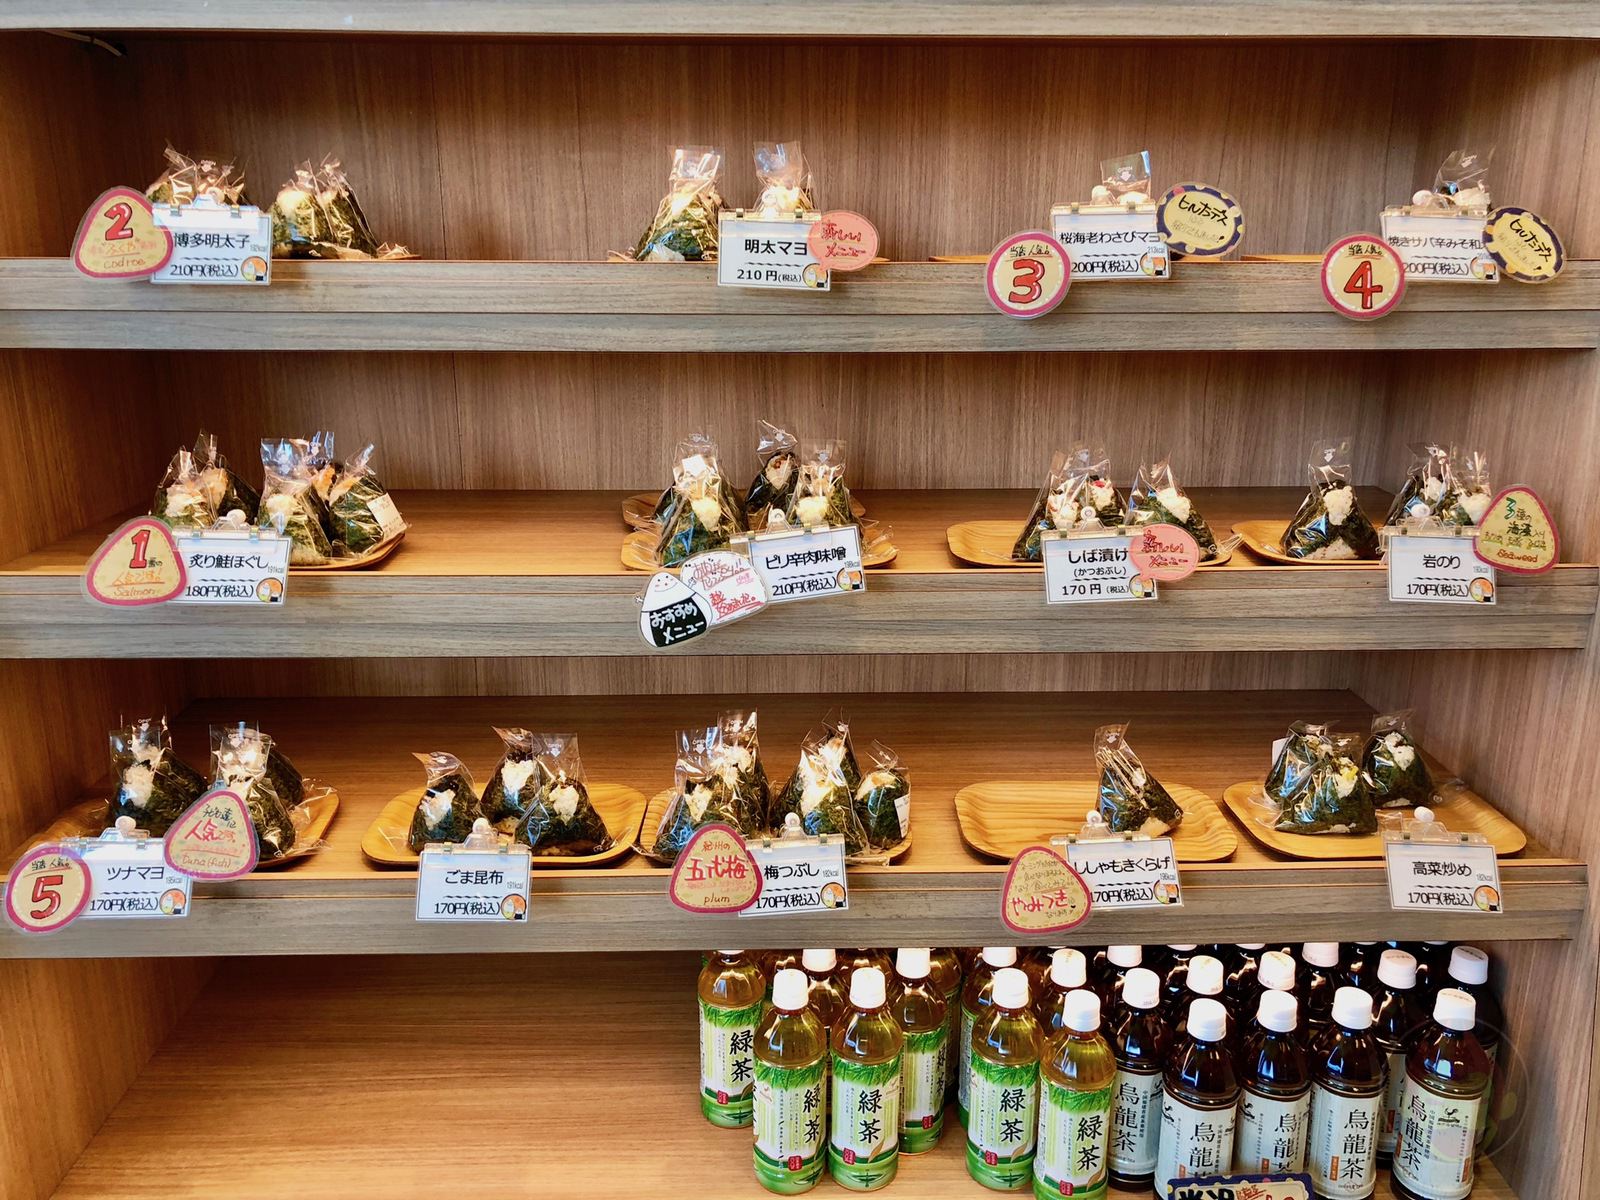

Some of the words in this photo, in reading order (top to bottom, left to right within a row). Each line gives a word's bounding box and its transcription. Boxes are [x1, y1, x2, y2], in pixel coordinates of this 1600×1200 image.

[104, 202, 133, 241] 2
[173, 233, 250, 249] 博多明太子
[744, 238, 808, 256] 明太マヨ
[1059, 231, 1162, 246] 桜海老わさびマヨ
[170, 263, 239, 277] 210円(税込)
[1071, 259, 1139, 274] 200円(税込)
[1403, 262, 1469, 276] 200円(税込)
[1008, 258, 1045, 304] 3
[1343, 260, 1383, 310] 4
[188, 553, 268, 569] 炙り鮭ほぐし
[765, 546, 847, 570] ピリ辛肉味噌
[1068, 547, 1128, 564] しば漬け
[1422, 554, 1461, 569] 岩のり
[1497, 548, 1538, 563] Seaweed
[1073, 566, 1127, 578] (かつおぶし)
[185, 584, 254, 598] 180円(税込)
[772, 576, 837, 597] 210円(税込)
[1407, 583, 1469, 597] 170円(税込)
[650, 602, 698, 630] おすすめ
[663, 620, 705, 644] メニュー
[107, 866, 165, 881] ツナマヨ
[684, 855, 749, 881] 五代梅
[764, 862, 820, 880] 梅つぶし
[1074, 856, 1170, 875] ししゃもきくらげ
[1412, 861, 1472, 877] 高菜炒め
[445, 869, 504, 885] ごま昆布
[30, 874, 63, 919] 5
[90, 897, 159, 912] 170円(税込)
[703, 893, 730, 905] plum
[755, 893, 821, 909] 170円(税込)
[1091, 888, 1154, 904] 170円(税込)
[1408, 892, 1474, 907] 170円(税込)
[434, 902, 501, 915] 170円(税込)
[729, 1029, 753, 1082] 緑茶
[802, 1083, 821, 1144] 緑茶
[858, 1089, 883, 1144] 緑茶
[999, 1088, 1026, 1143] 緑茶
[1112, 1082, 1140, 1153] 烏龍茶
[1402, 1095, 1428, 1171] 烏龍茶
[1076, 1115, 1103, 1171] 緑茶
[1189, 1122, 1216, 1176] 烏龍
[1340, 1109, 1370, 1179] 烏龍茶
